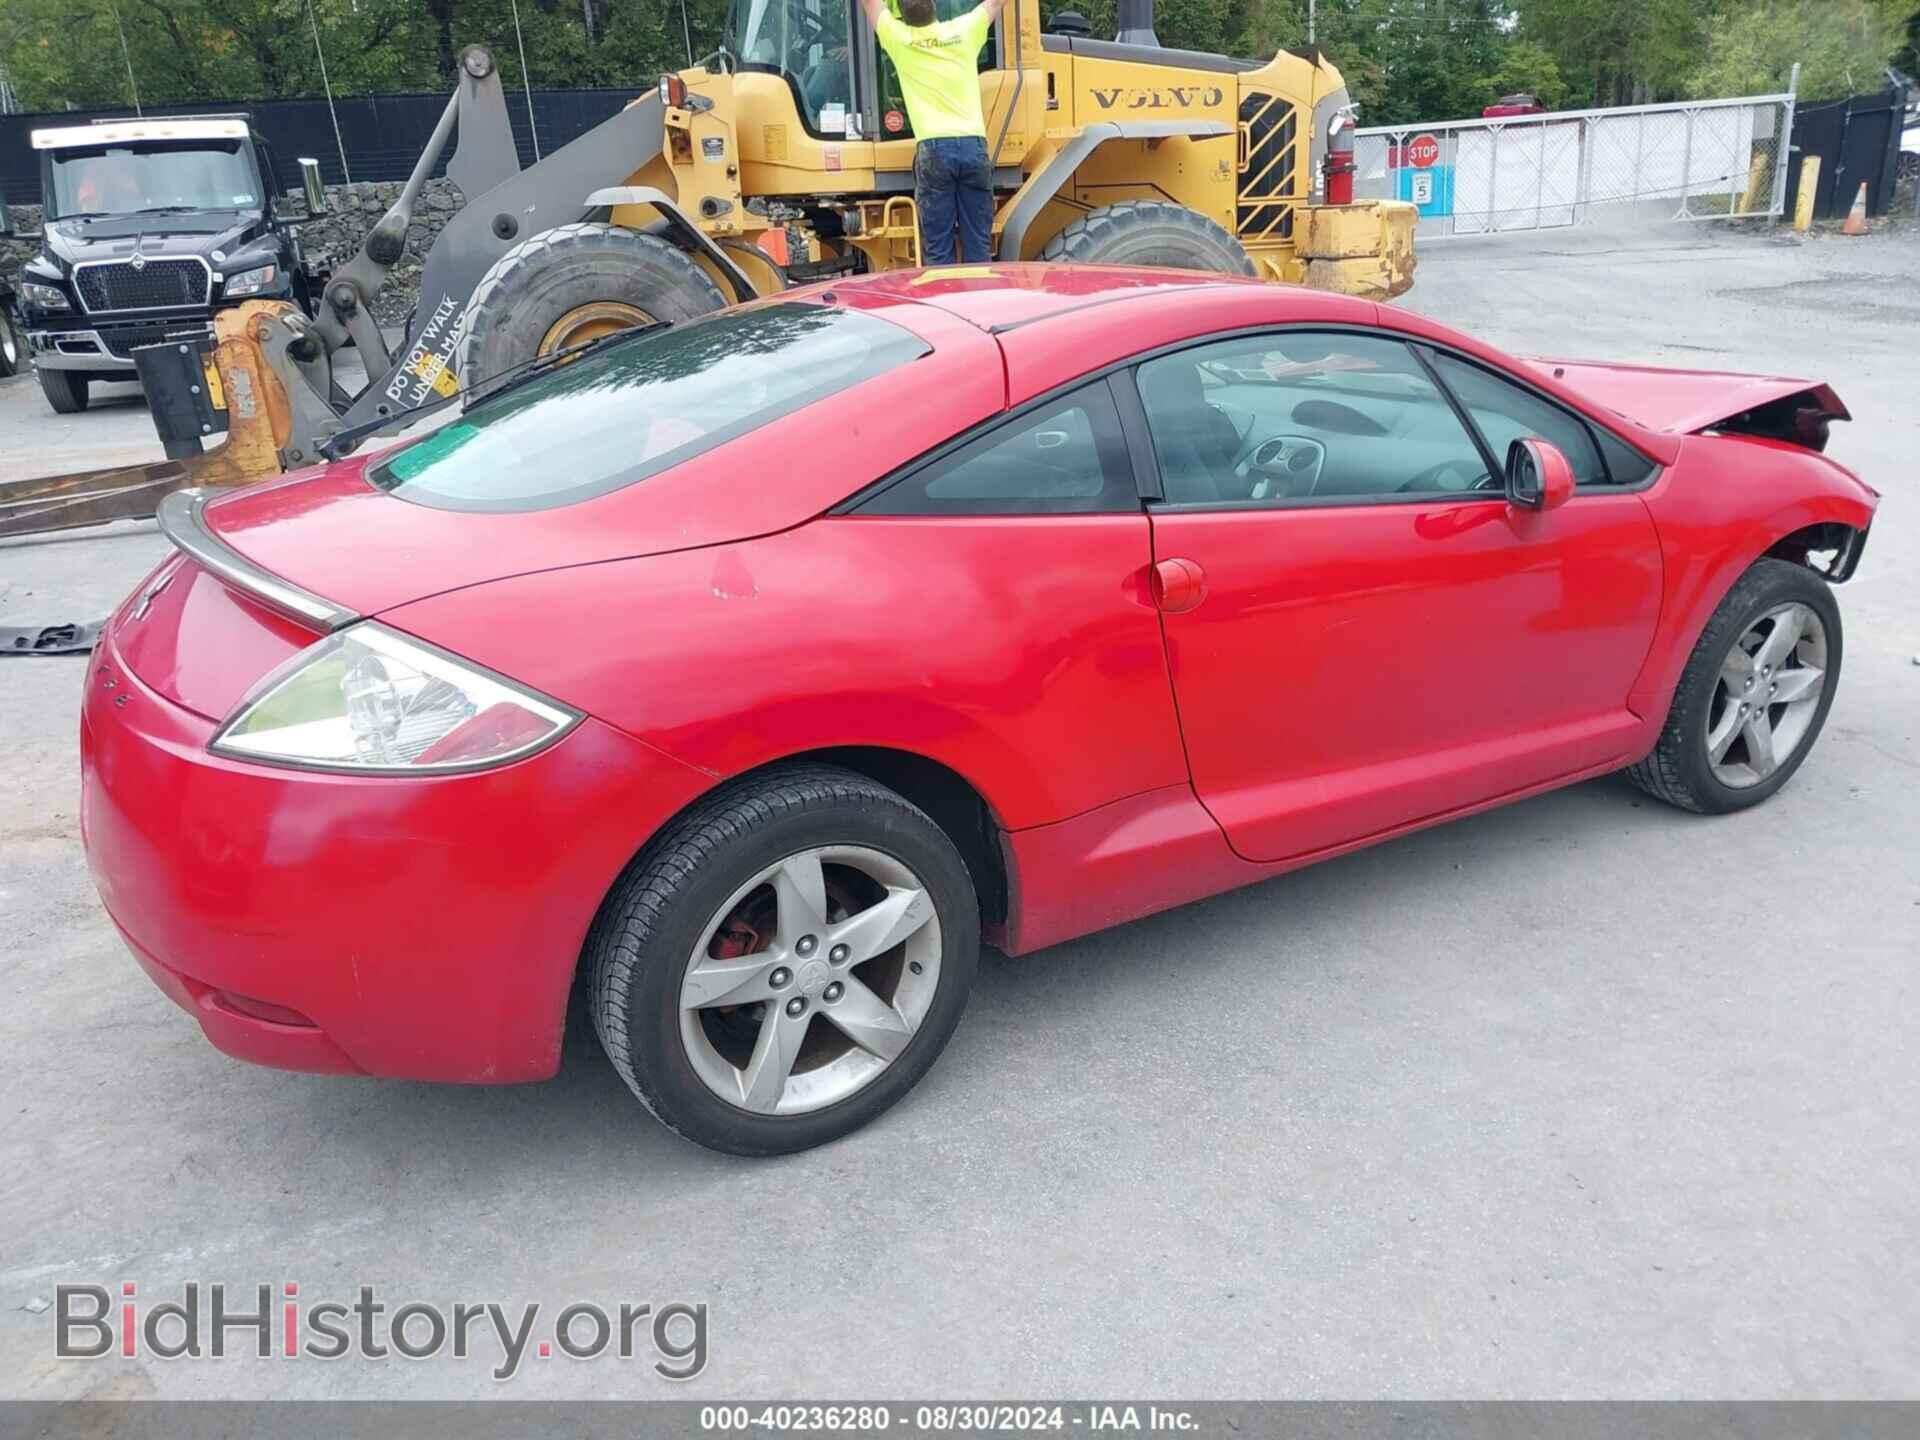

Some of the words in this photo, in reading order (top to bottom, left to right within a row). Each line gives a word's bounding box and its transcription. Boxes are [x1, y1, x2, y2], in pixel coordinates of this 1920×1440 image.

[1089, 87, 1223, 109] VOLVO
[1410, 144, 1437, 160] STOP
[1418, 185, 1427, 197] 5
[387, 375, 409, 400] DO
[404, 339, 431, 375] NOT
[424, 296, 459, 339] WALK
[409, 352, 447, 401] UNDER
